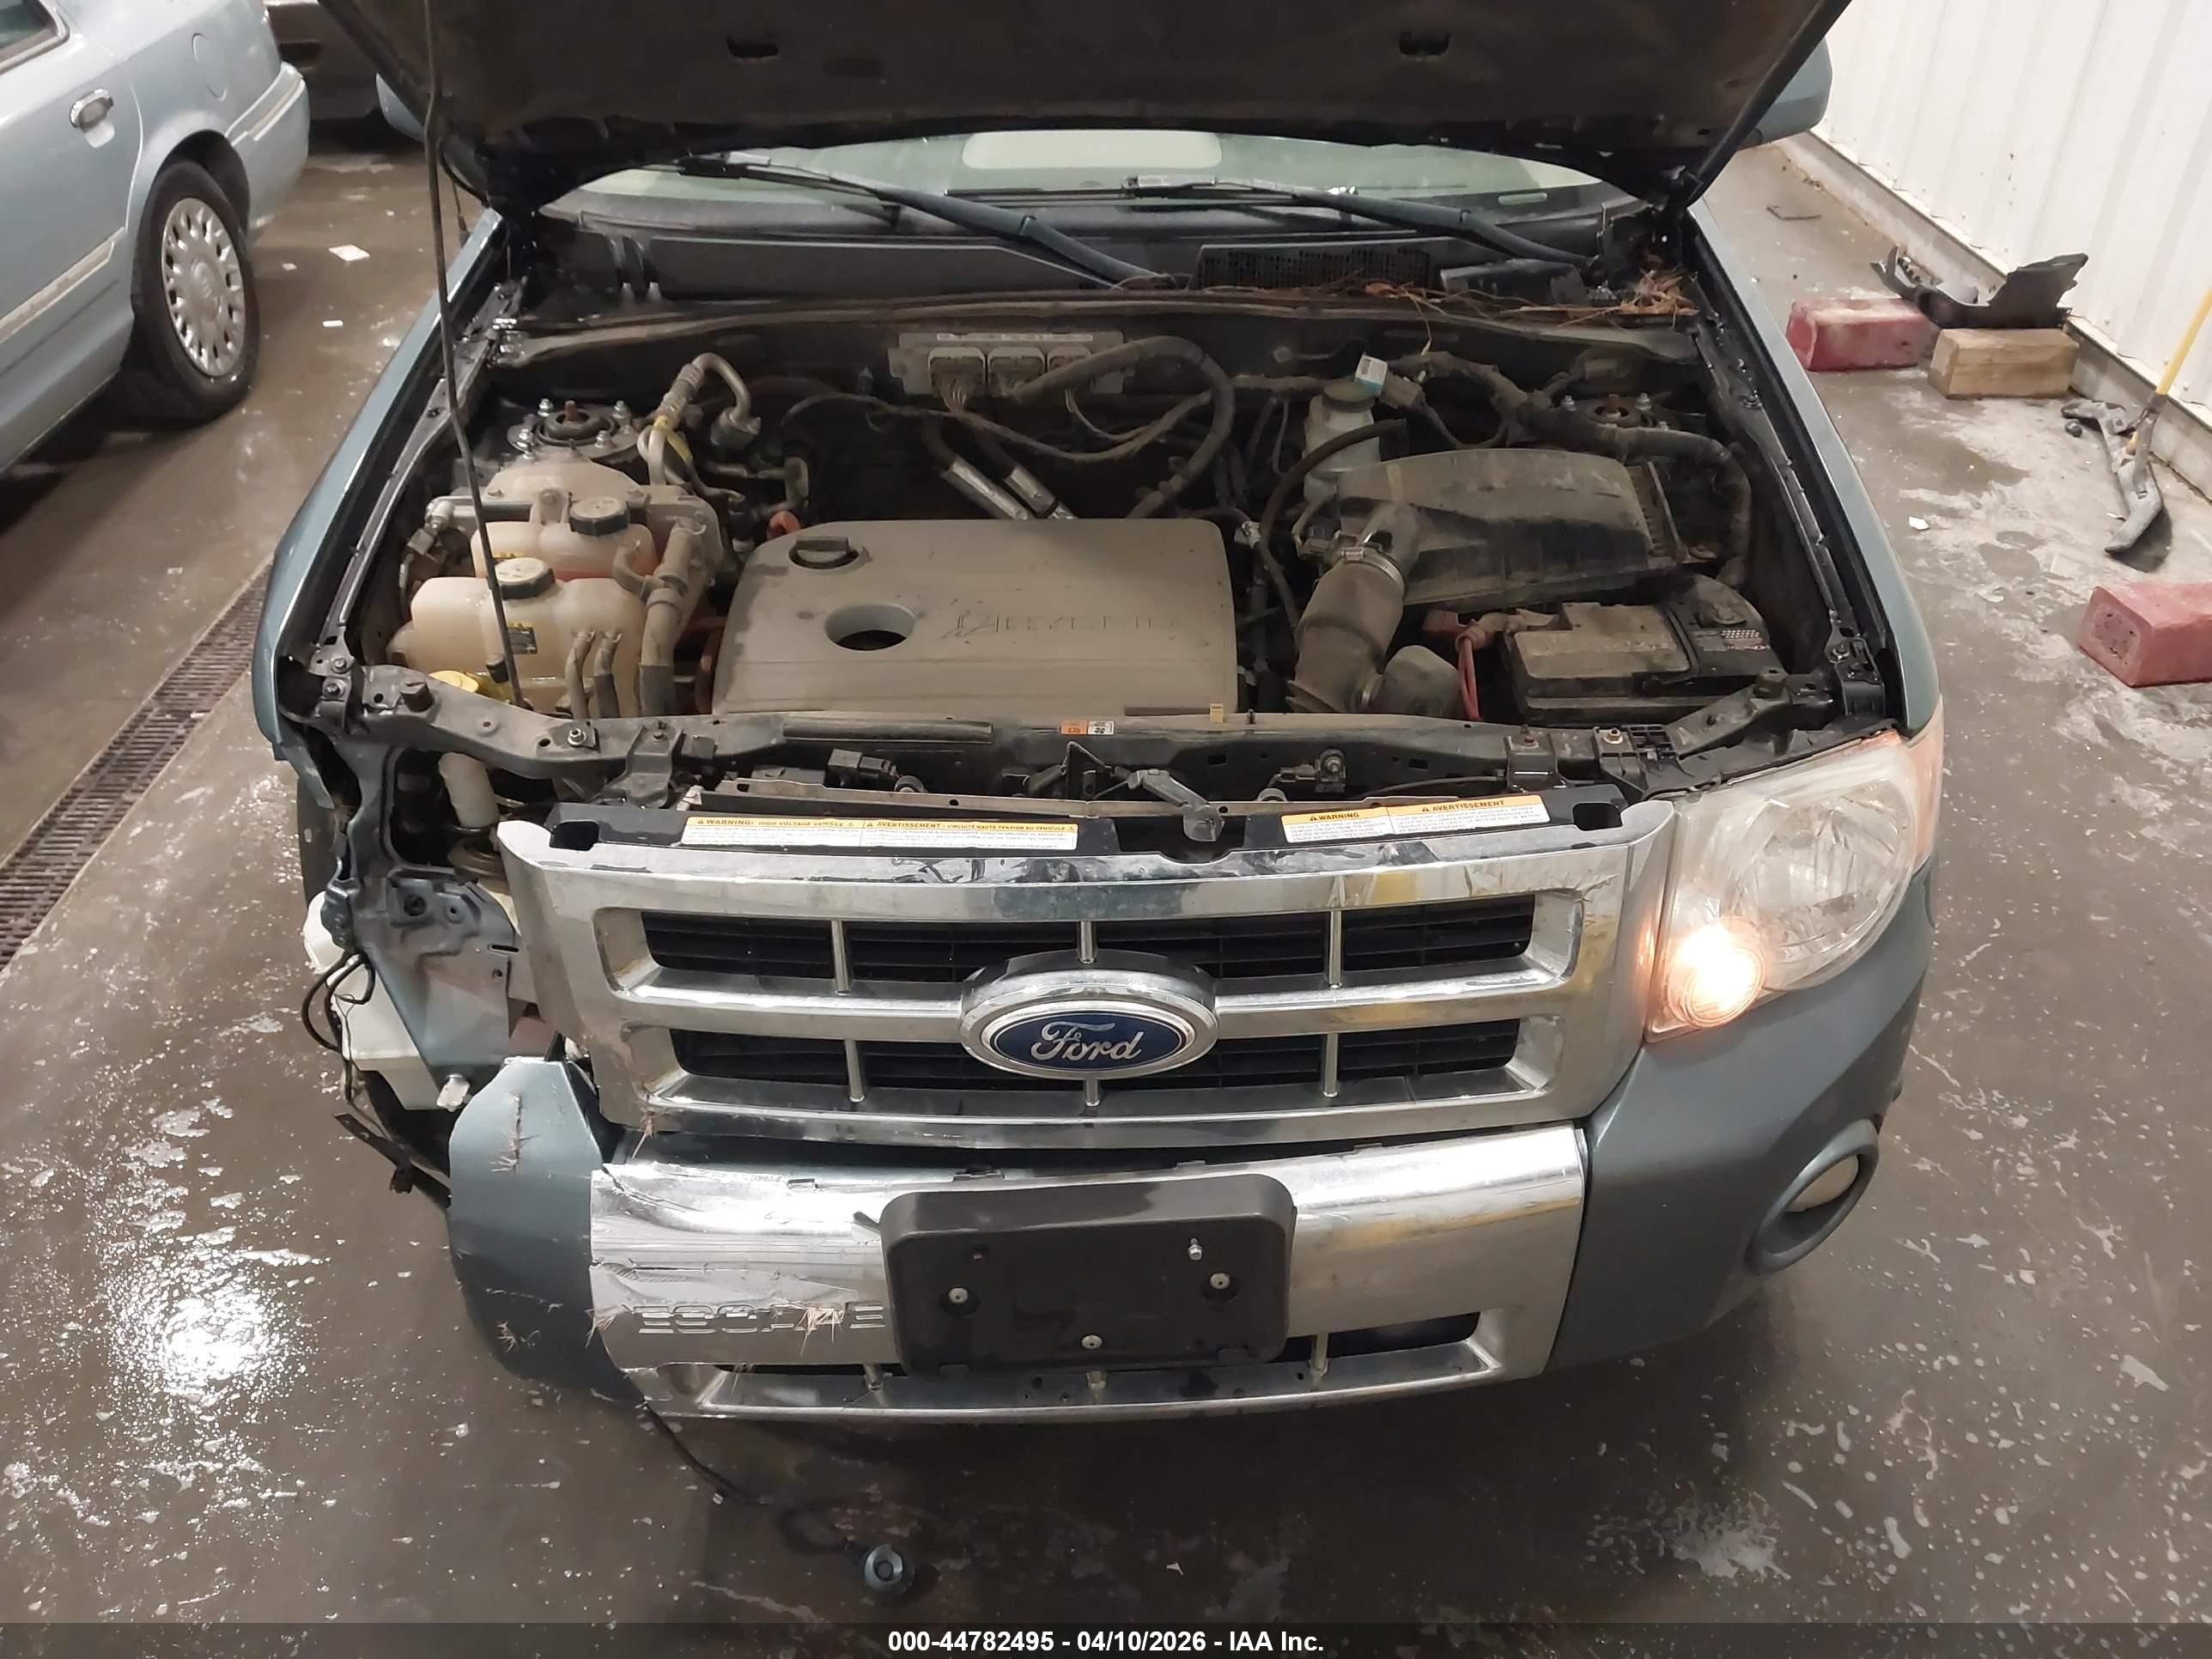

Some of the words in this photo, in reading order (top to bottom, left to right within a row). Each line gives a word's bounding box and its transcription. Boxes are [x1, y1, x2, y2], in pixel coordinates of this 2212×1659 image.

[1432, 800, 1505, 812] AVERTISSEMENT
[1318, 812, 1360, 821] WARNING
[1030, 1020, 1145, 1060] Ford
